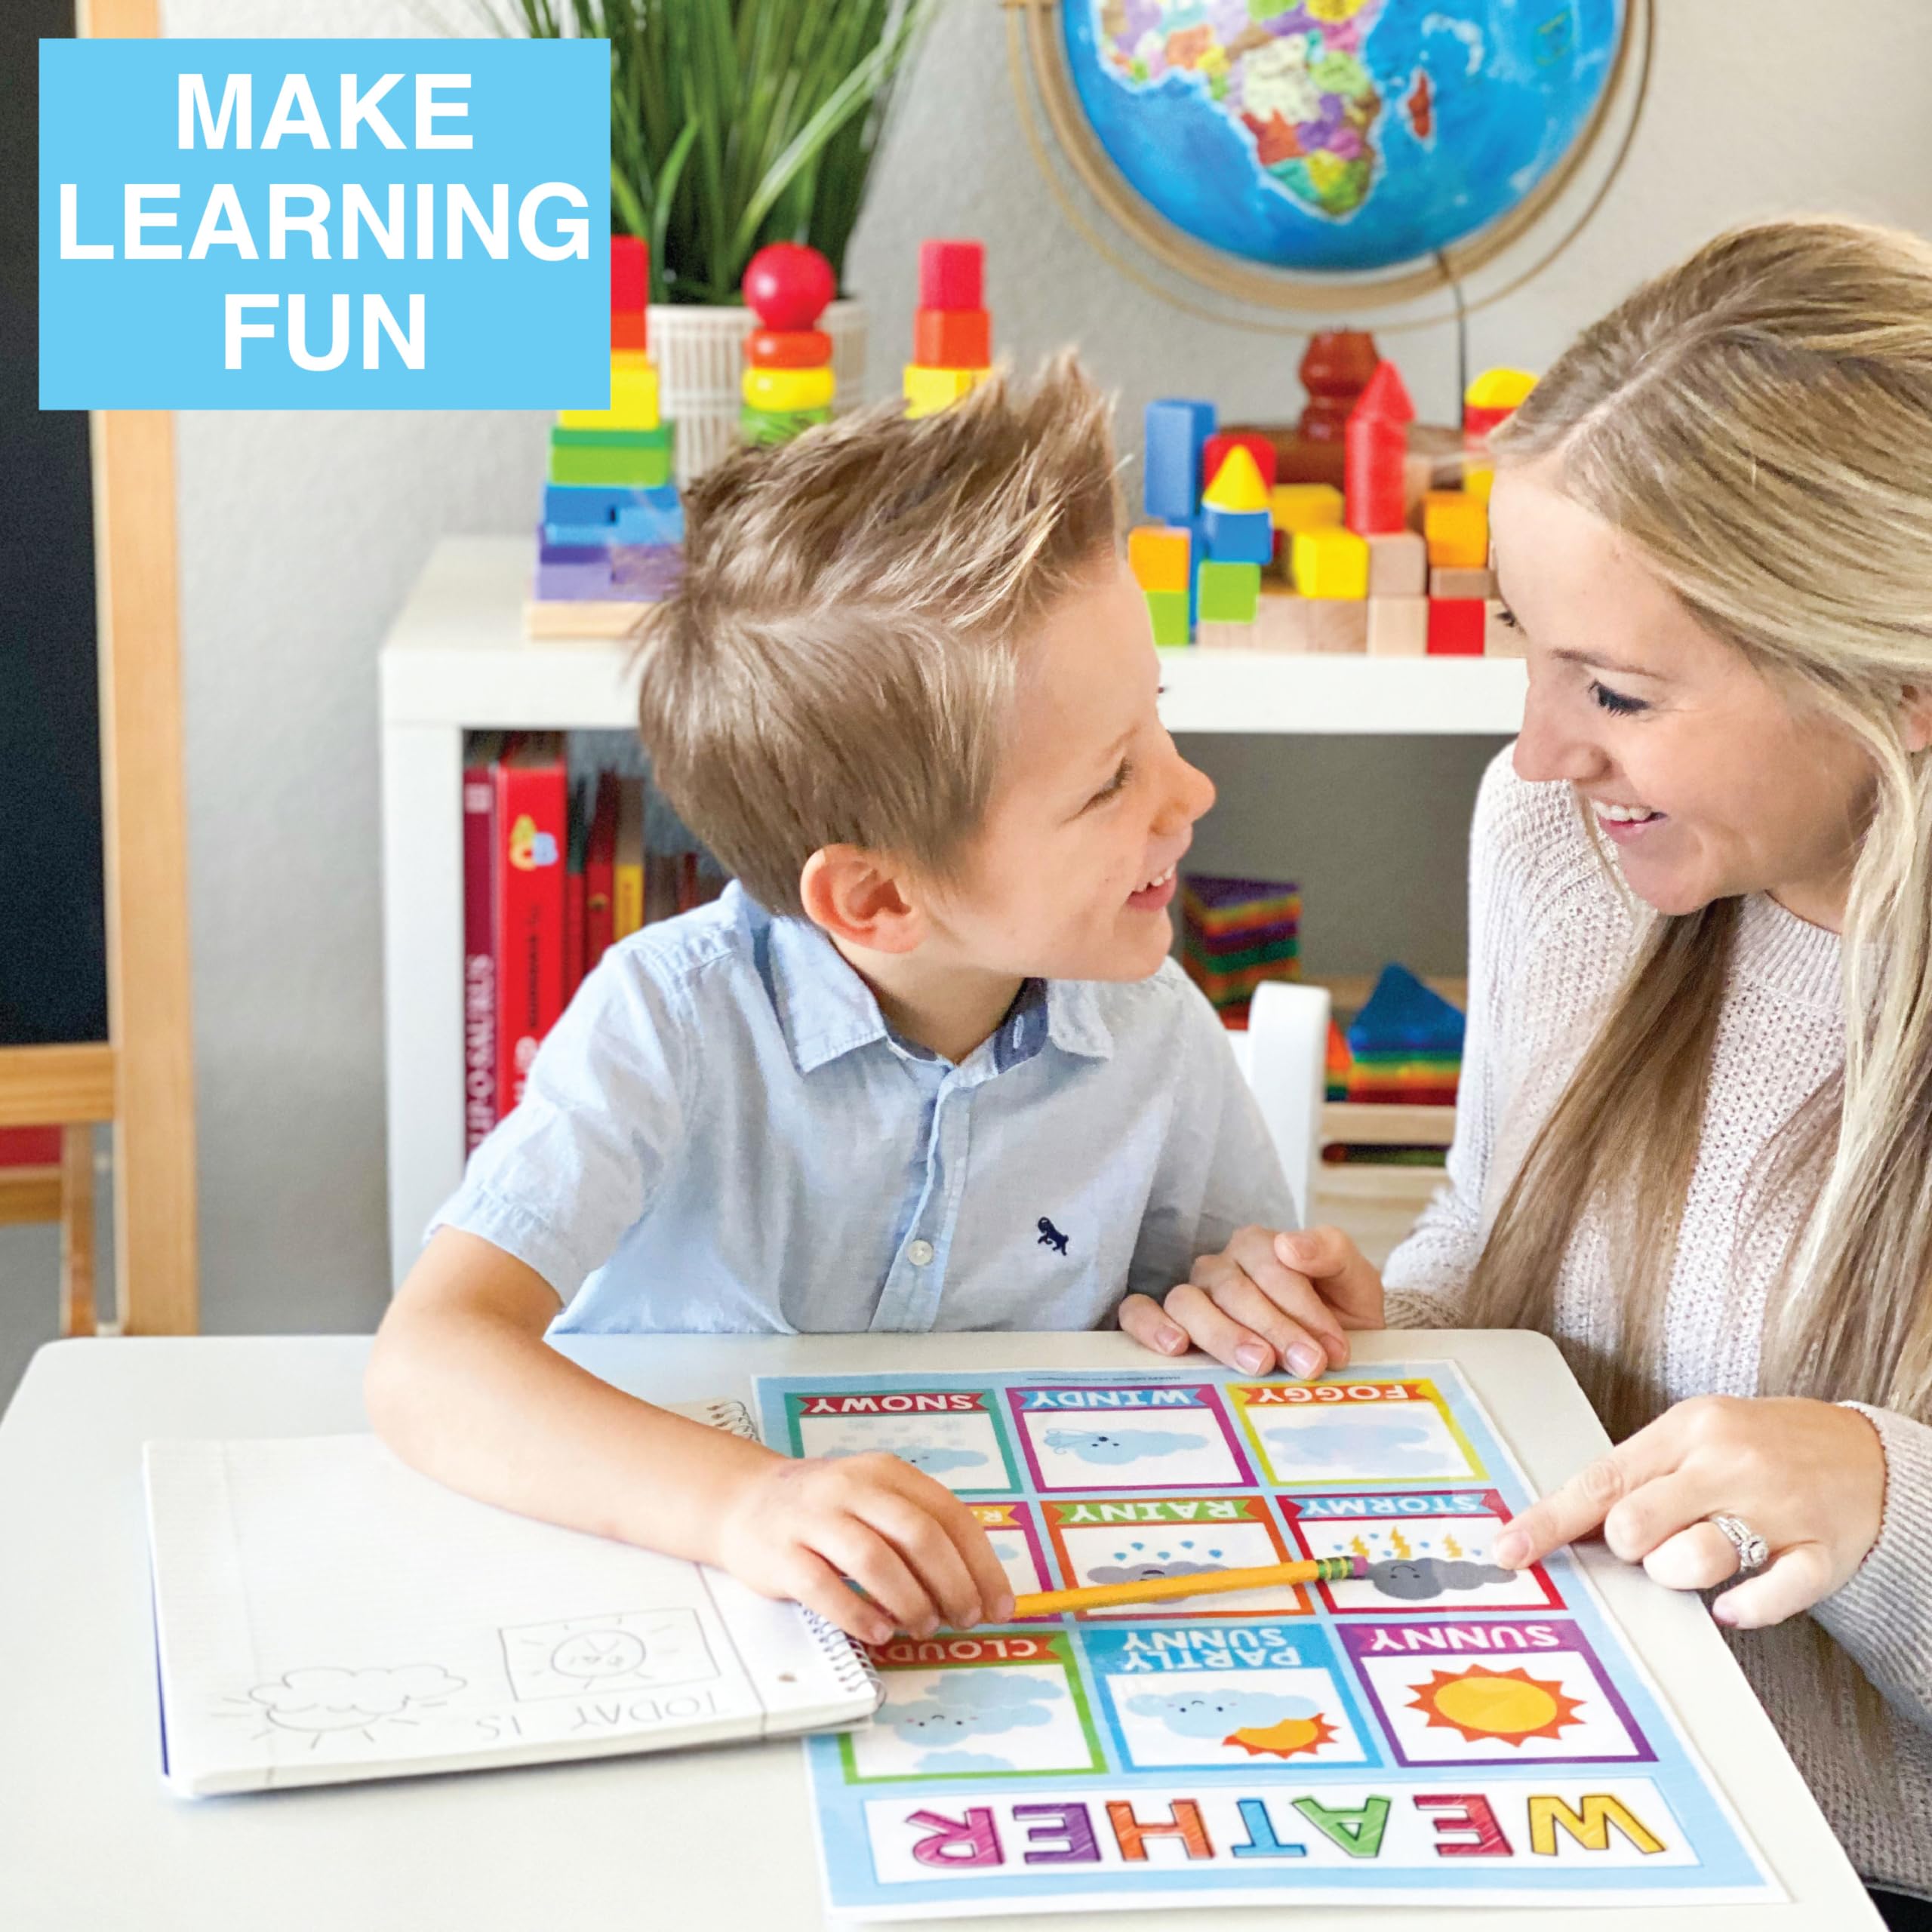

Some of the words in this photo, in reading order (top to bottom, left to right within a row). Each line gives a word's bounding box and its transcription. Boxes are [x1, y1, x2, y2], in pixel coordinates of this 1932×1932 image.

[810, 1392, 975, 1414] SNOWY
[1031, 1389, 1190, 1407] WINDY
[1258, 1383, 1408, 1404] FOGGY
[1070, 1500, 1238, 1524] RAINY
[1304, 1496, 1475, 1515] STORMY
[1120, 1628, 1284, 1652] SUNNY
[1371, 1624, 1561, 1651] SUNNY
[869, 1638, 1038, 1662] CLOUDY
[1124, 1646, 1300, 1669] PARTLY
[571, 1691, 730, 1731] TODAY
[475, 1715, 522, 1740] IS
[904, 1793, 1666, 1866] WEATHER
